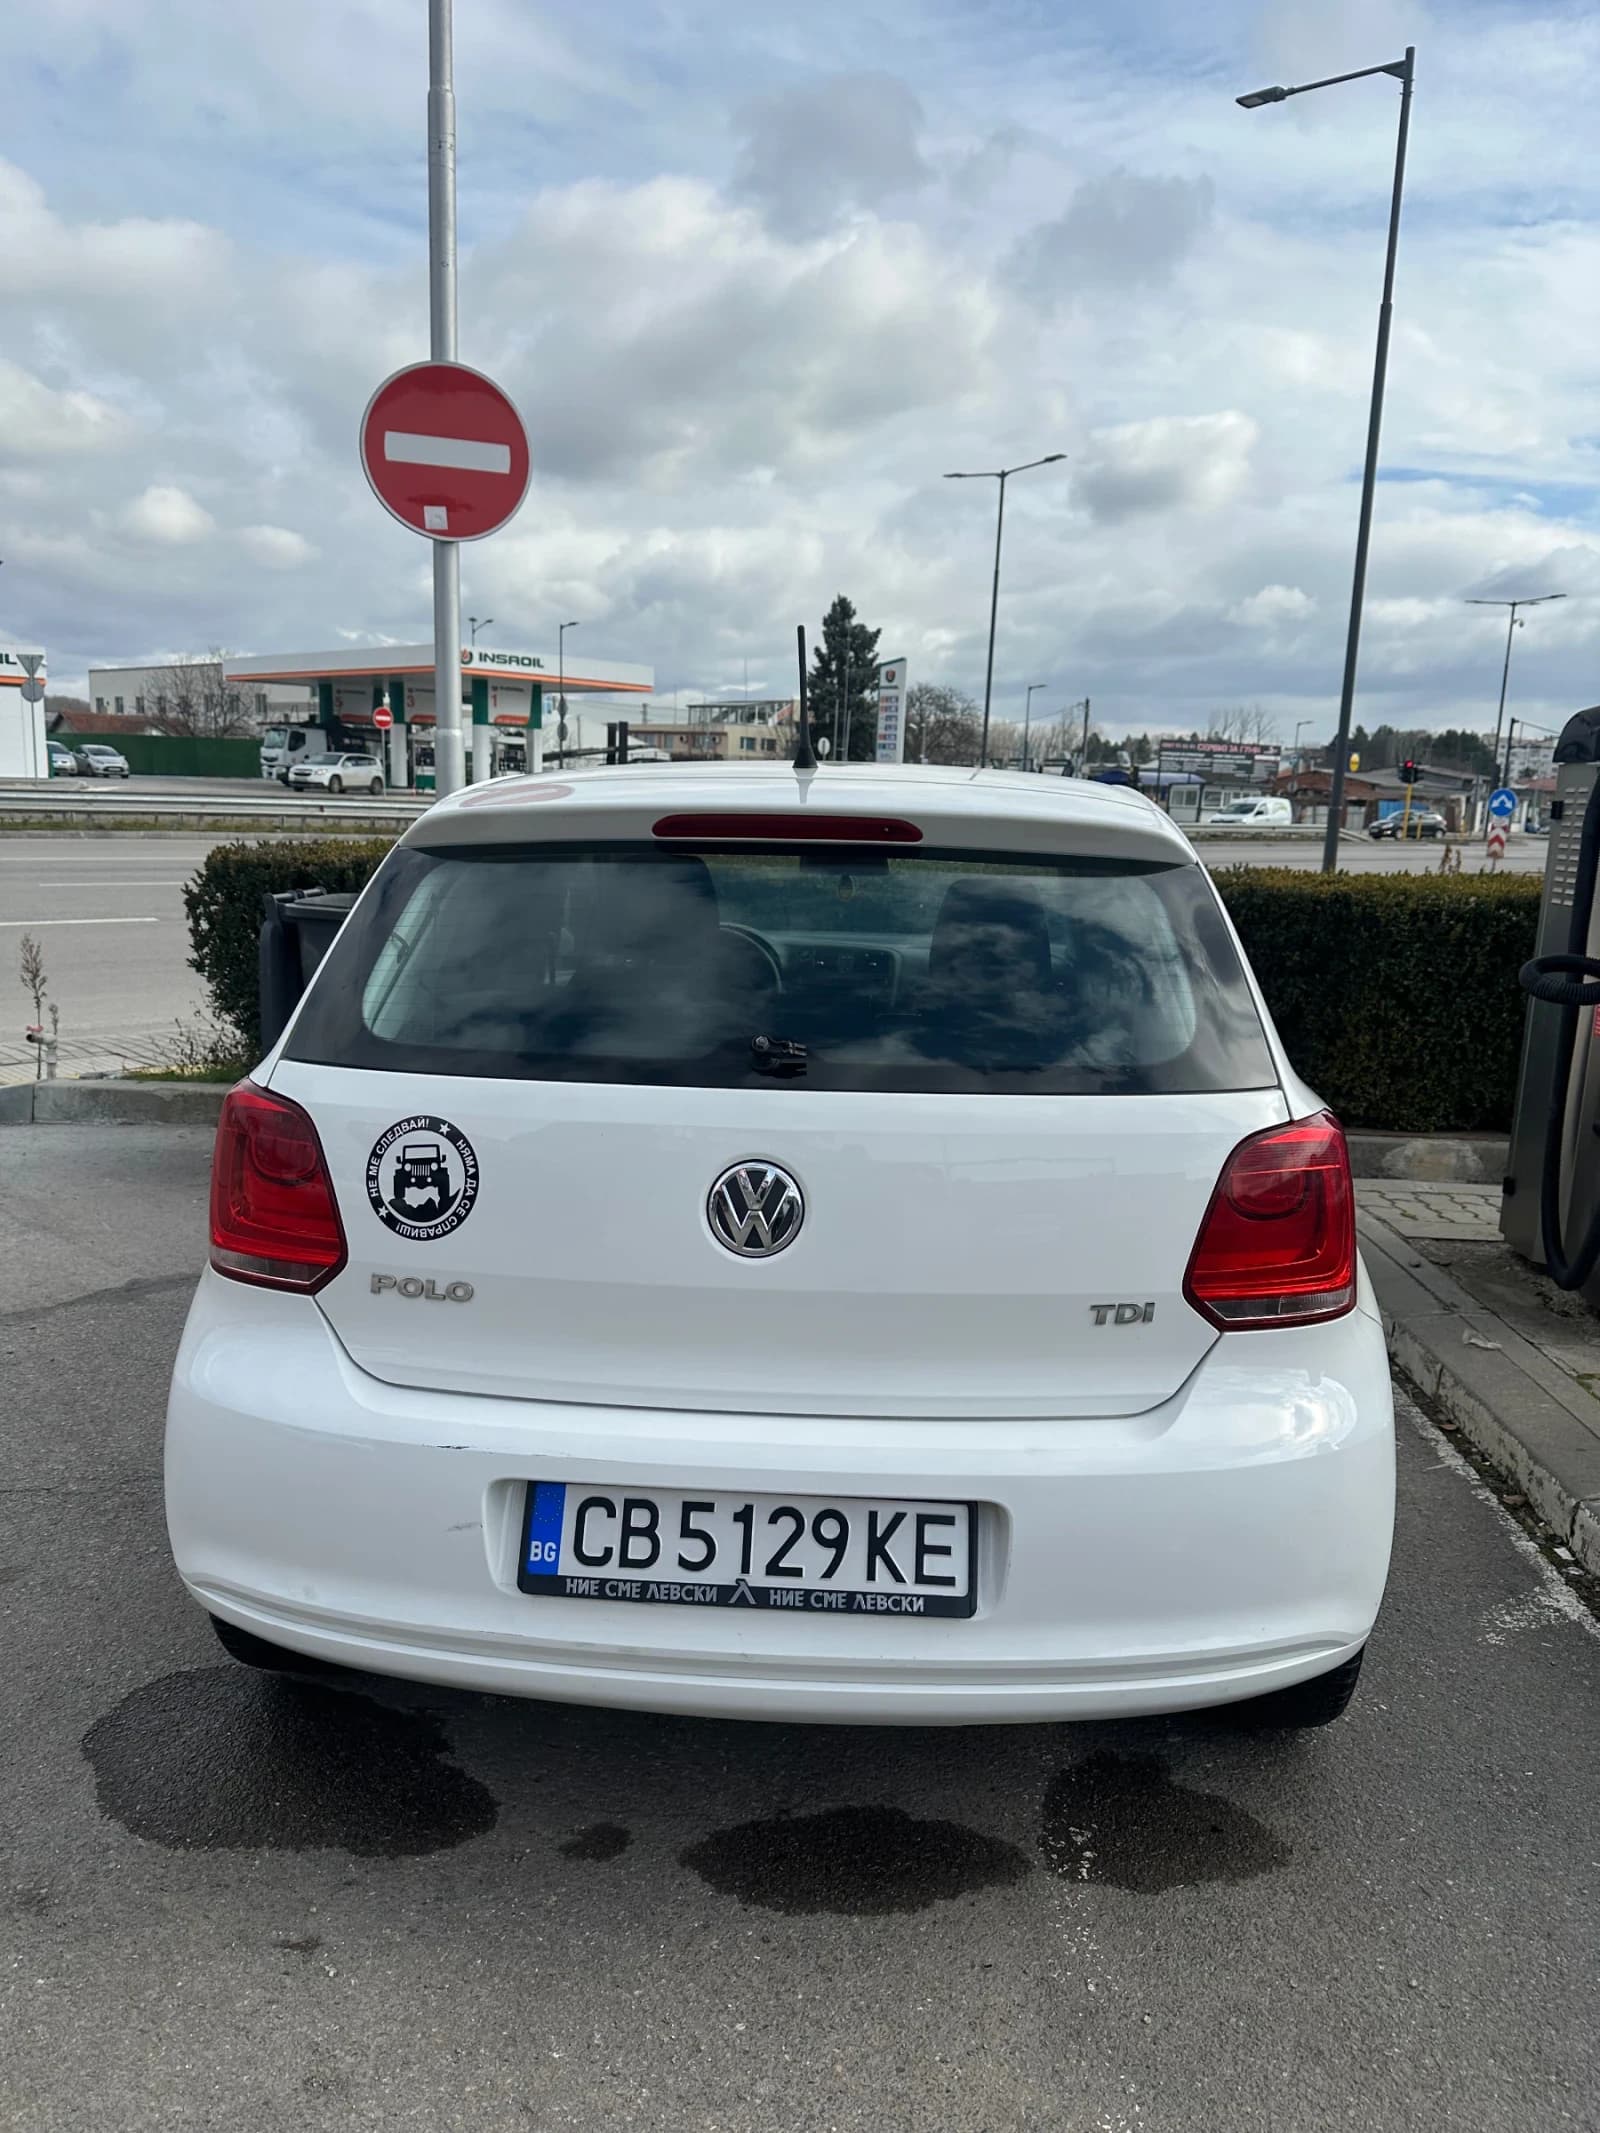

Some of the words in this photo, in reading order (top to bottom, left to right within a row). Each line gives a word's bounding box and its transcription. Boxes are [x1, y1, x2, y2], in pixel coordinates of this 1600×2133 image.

[376, 1116, 430, 1155] СЛЕДВАЙ!
[368, 1156, 380, 1177] МЕ
[456, 1138, 477, 1176] НЯМА
[368, 1179, 379, 1199] НЕ
[465, 1178, 478, 1197] ДА
[455, 1199, 472, 1217] СЕ
[395, 1215, 459, 1239] СПРАВИШ!
[369, 1272, 475, 1303] POLO
[1089, 1302, 1156, 1326] TDI
[529, 1539, 558, 1564] BG
[677, 1501, 850, 1579] 5129
[565, 1578, 600, 1597] НИЕ
[605, 1580, 641, 1599] СМЕ
[769, 1589, 805, 1608] НИЕ
[810, 1591, 848, 1610] СМЕ
